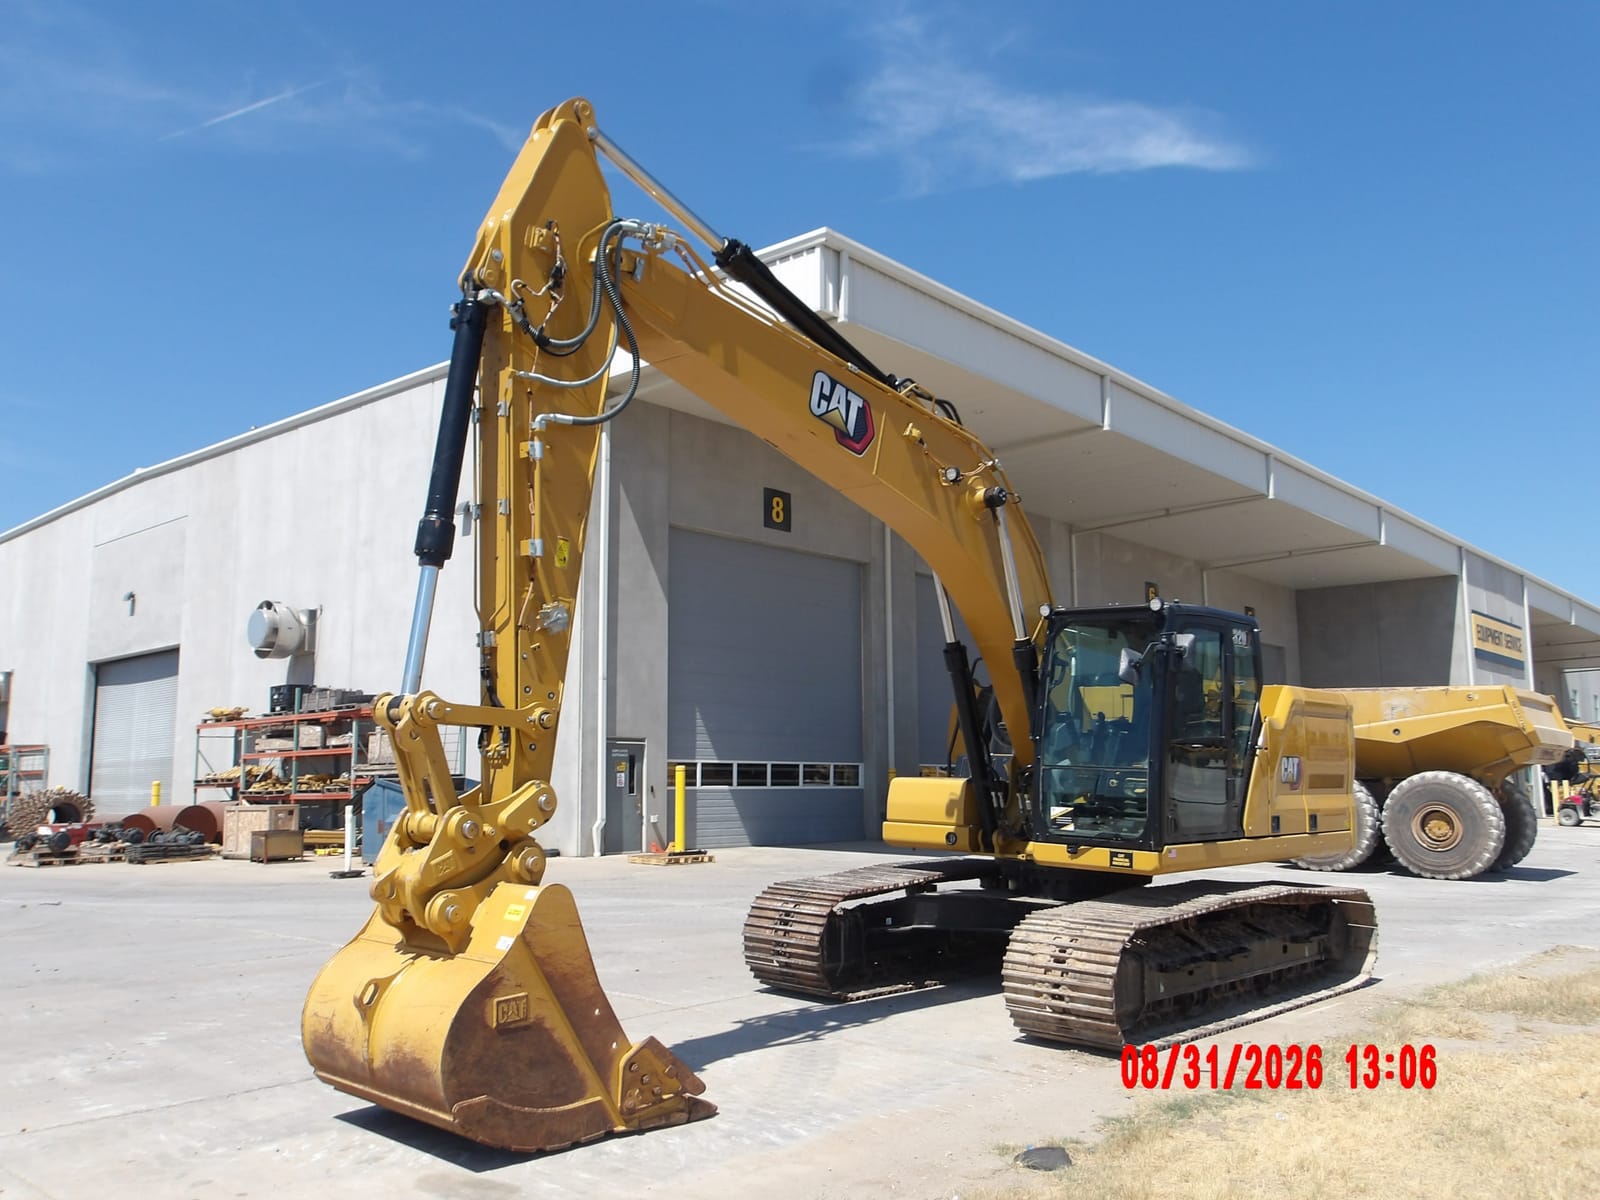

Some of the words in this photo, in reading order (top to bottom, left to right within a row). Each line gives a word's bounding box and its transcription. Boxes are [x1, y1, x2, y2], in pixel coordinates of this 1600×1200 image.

[810, 371, 864, 438] CAT
[772, 496, 784, 523] 8
[1476, 624, 1503, 648] EQUIPMENT
[1503, 633, 1523, 653] SERVICE
[1281, 756, 1299, 784] CAT
[498, 997, 528, 1024] CAT
